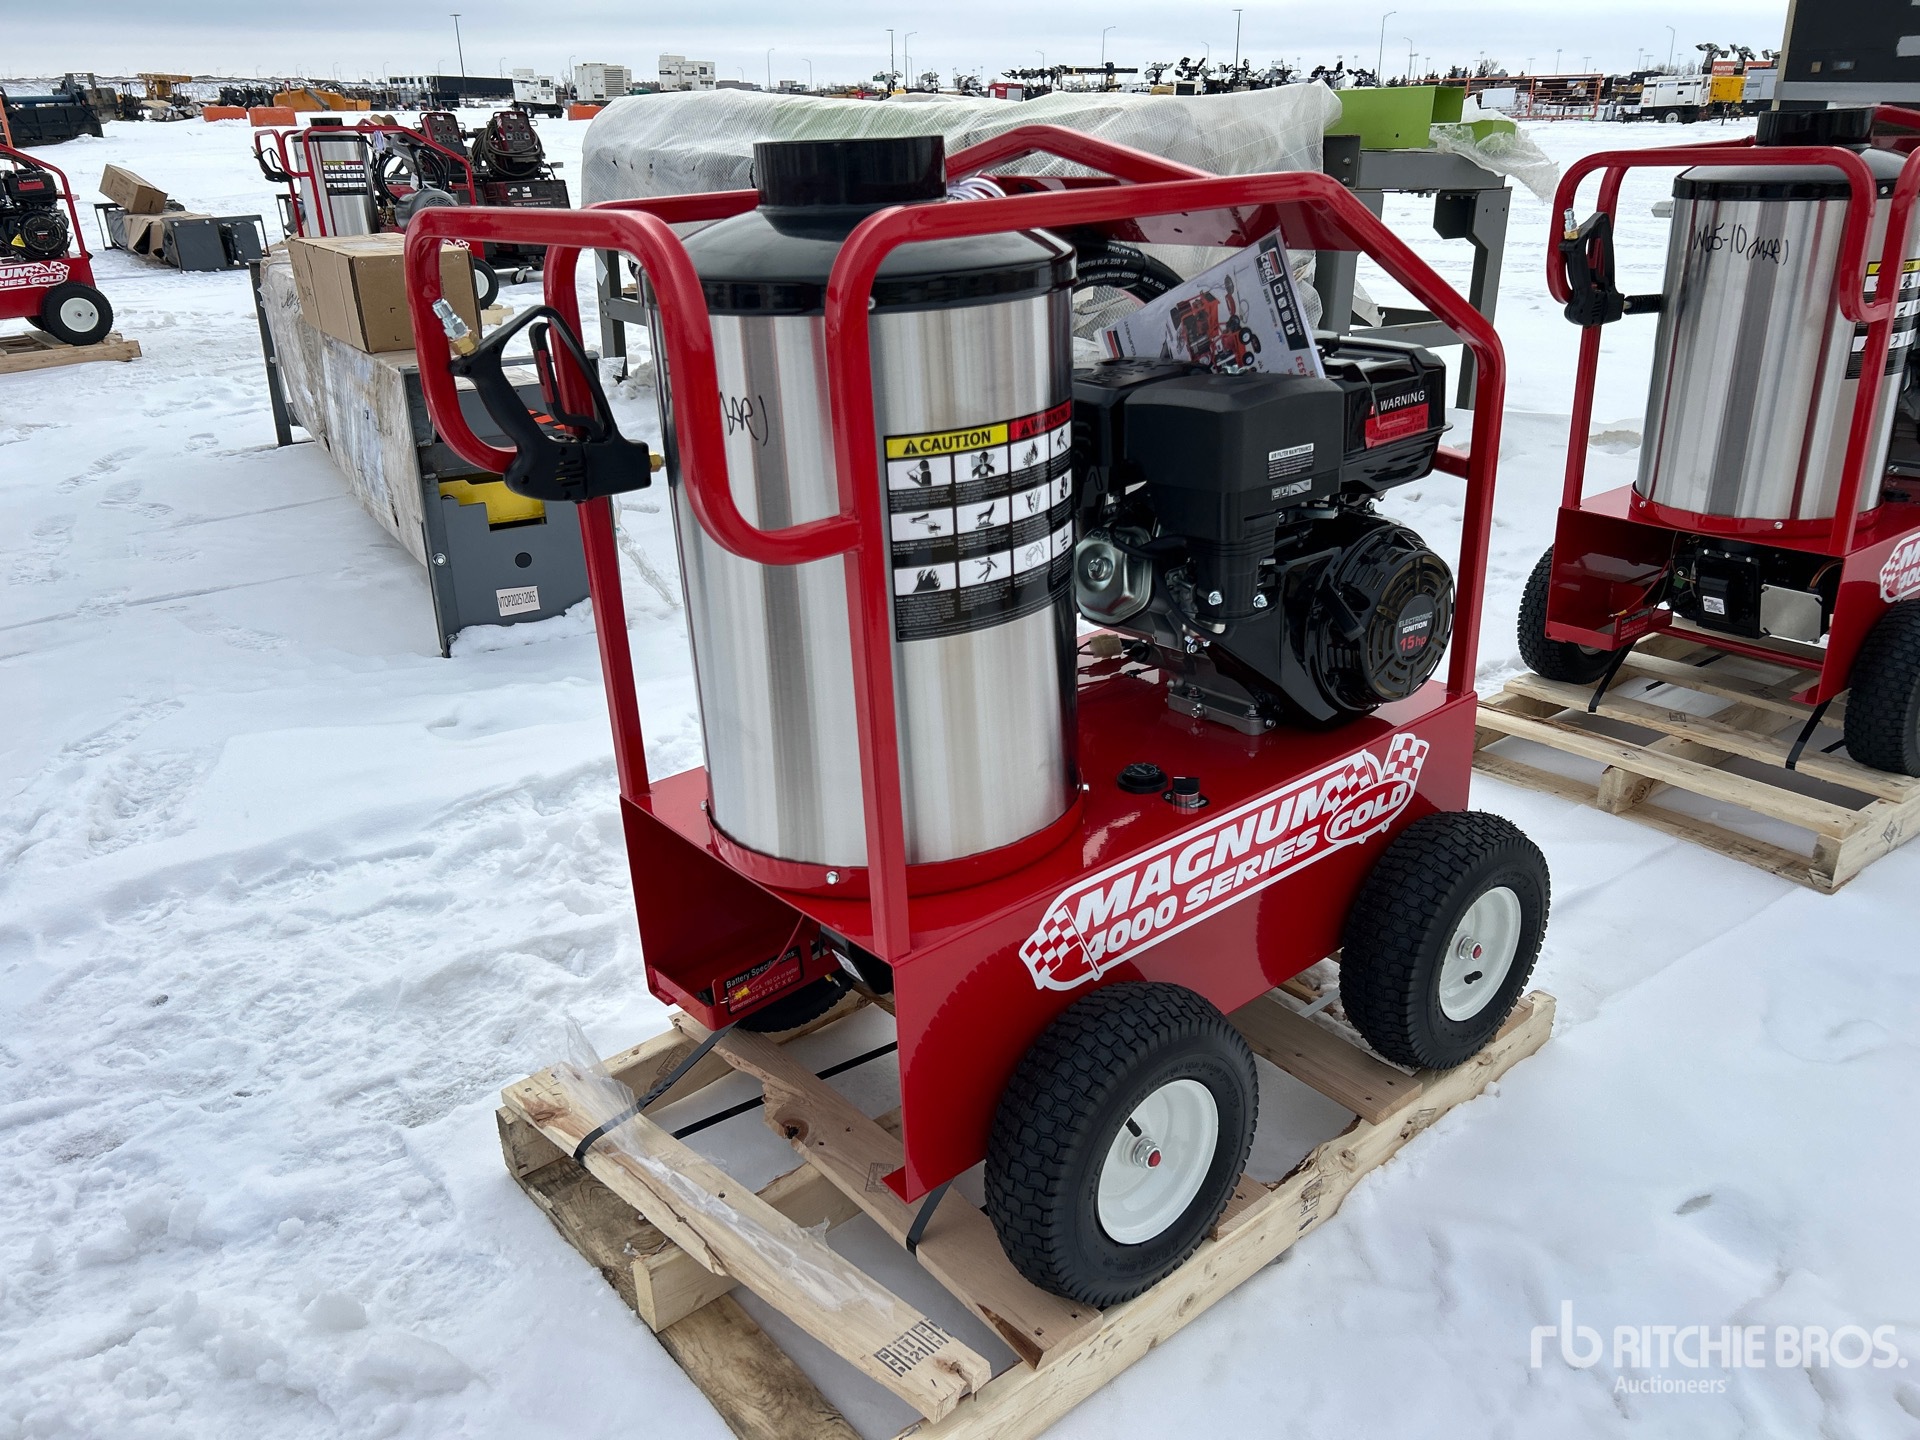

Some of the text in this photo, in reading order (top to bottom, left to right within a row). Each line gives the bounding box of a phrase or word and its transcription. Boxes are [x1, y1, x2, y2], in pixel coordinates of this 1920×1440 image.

[31, 274, 65, 285] GOLD
[1379, 389, 1426, 412] WARNING
[919, 429, 992, 454] CAUTION
[1398, 611, 1433, 628] ELECTRONIC
[1402, 620, 1428, 634] IGNITION
[1074, 773, 1345, 933] MAGNUM
[1081, 786, 1405, 963] 4000 SERIES GOLD
[726, 972, 750, 989] Battery
